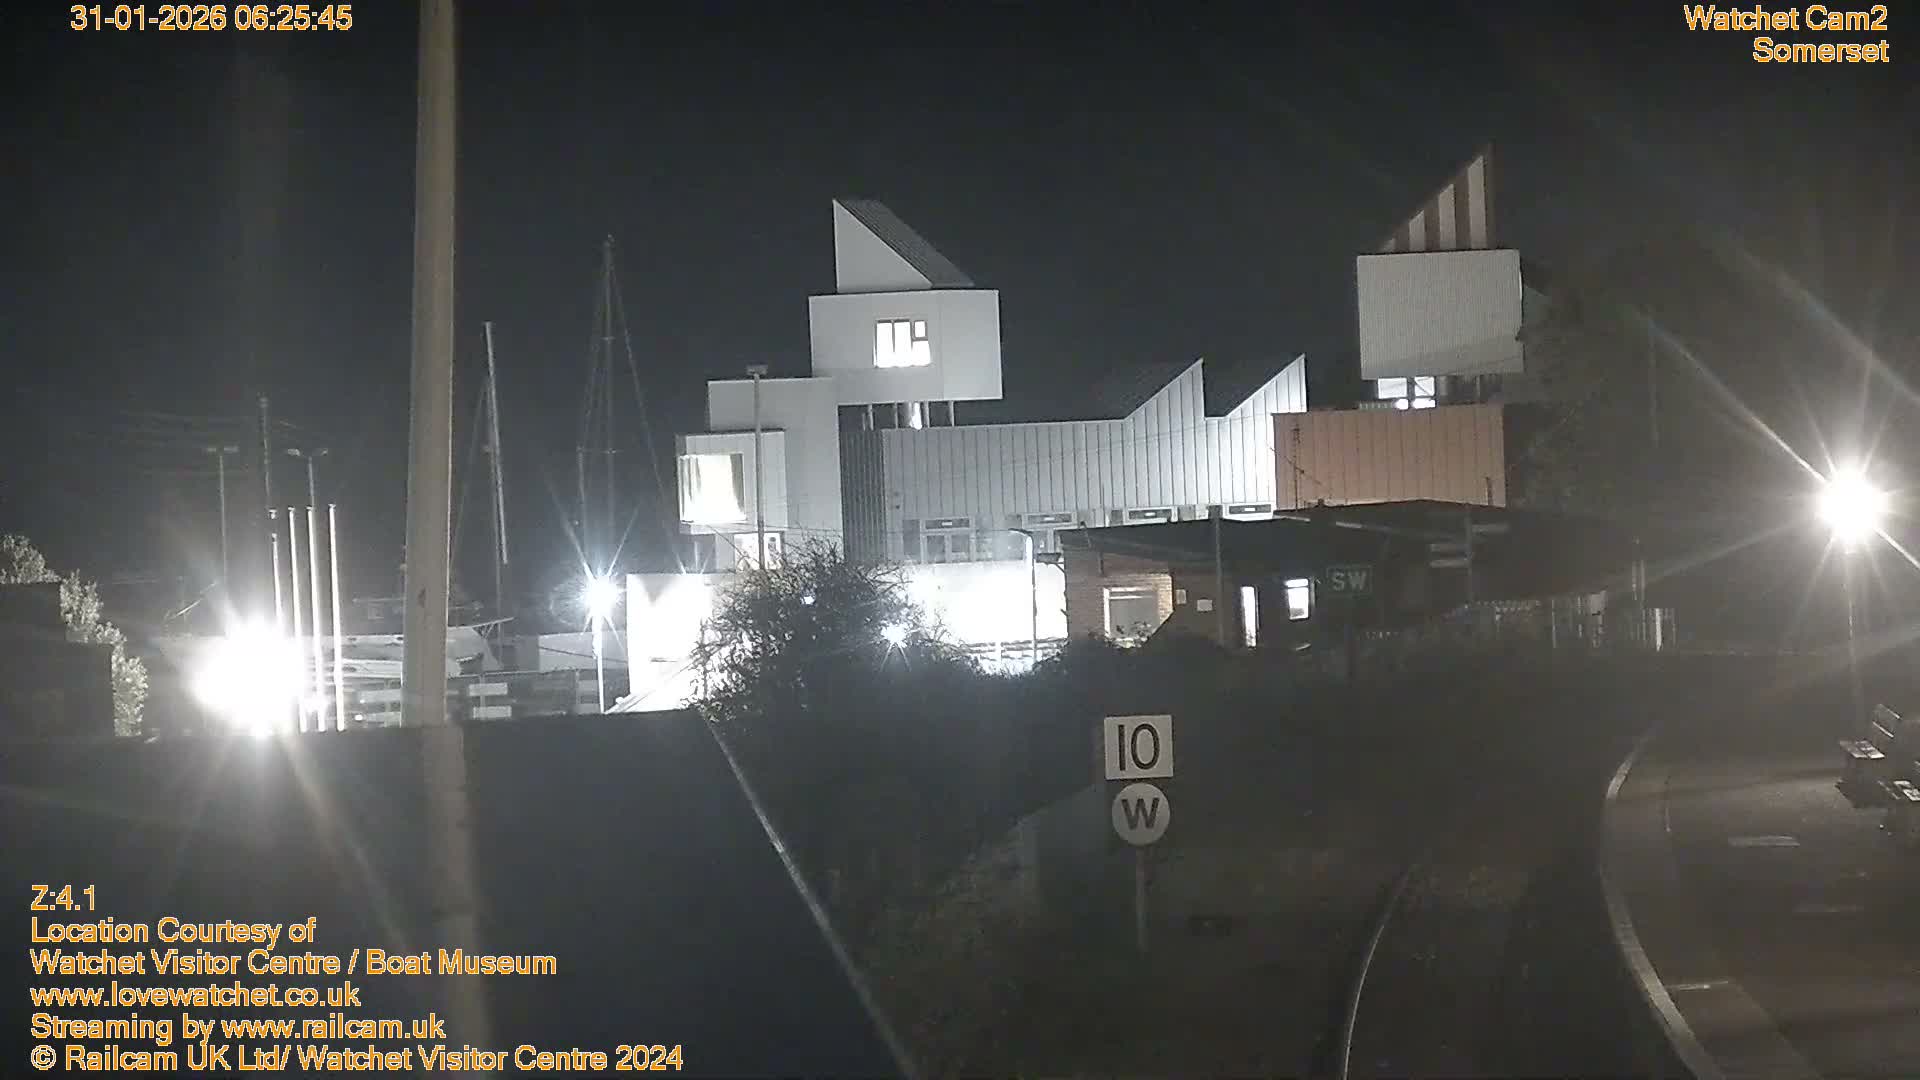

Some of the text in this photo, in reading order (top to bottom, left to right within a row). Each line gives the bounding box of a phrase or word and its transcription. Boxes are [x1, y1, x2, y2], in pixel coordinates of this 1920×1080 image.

[1332, 570, 1368, 592] SW
[1117, 723, 1160, 771] 10
[1121, 797, 1160, 830] W
